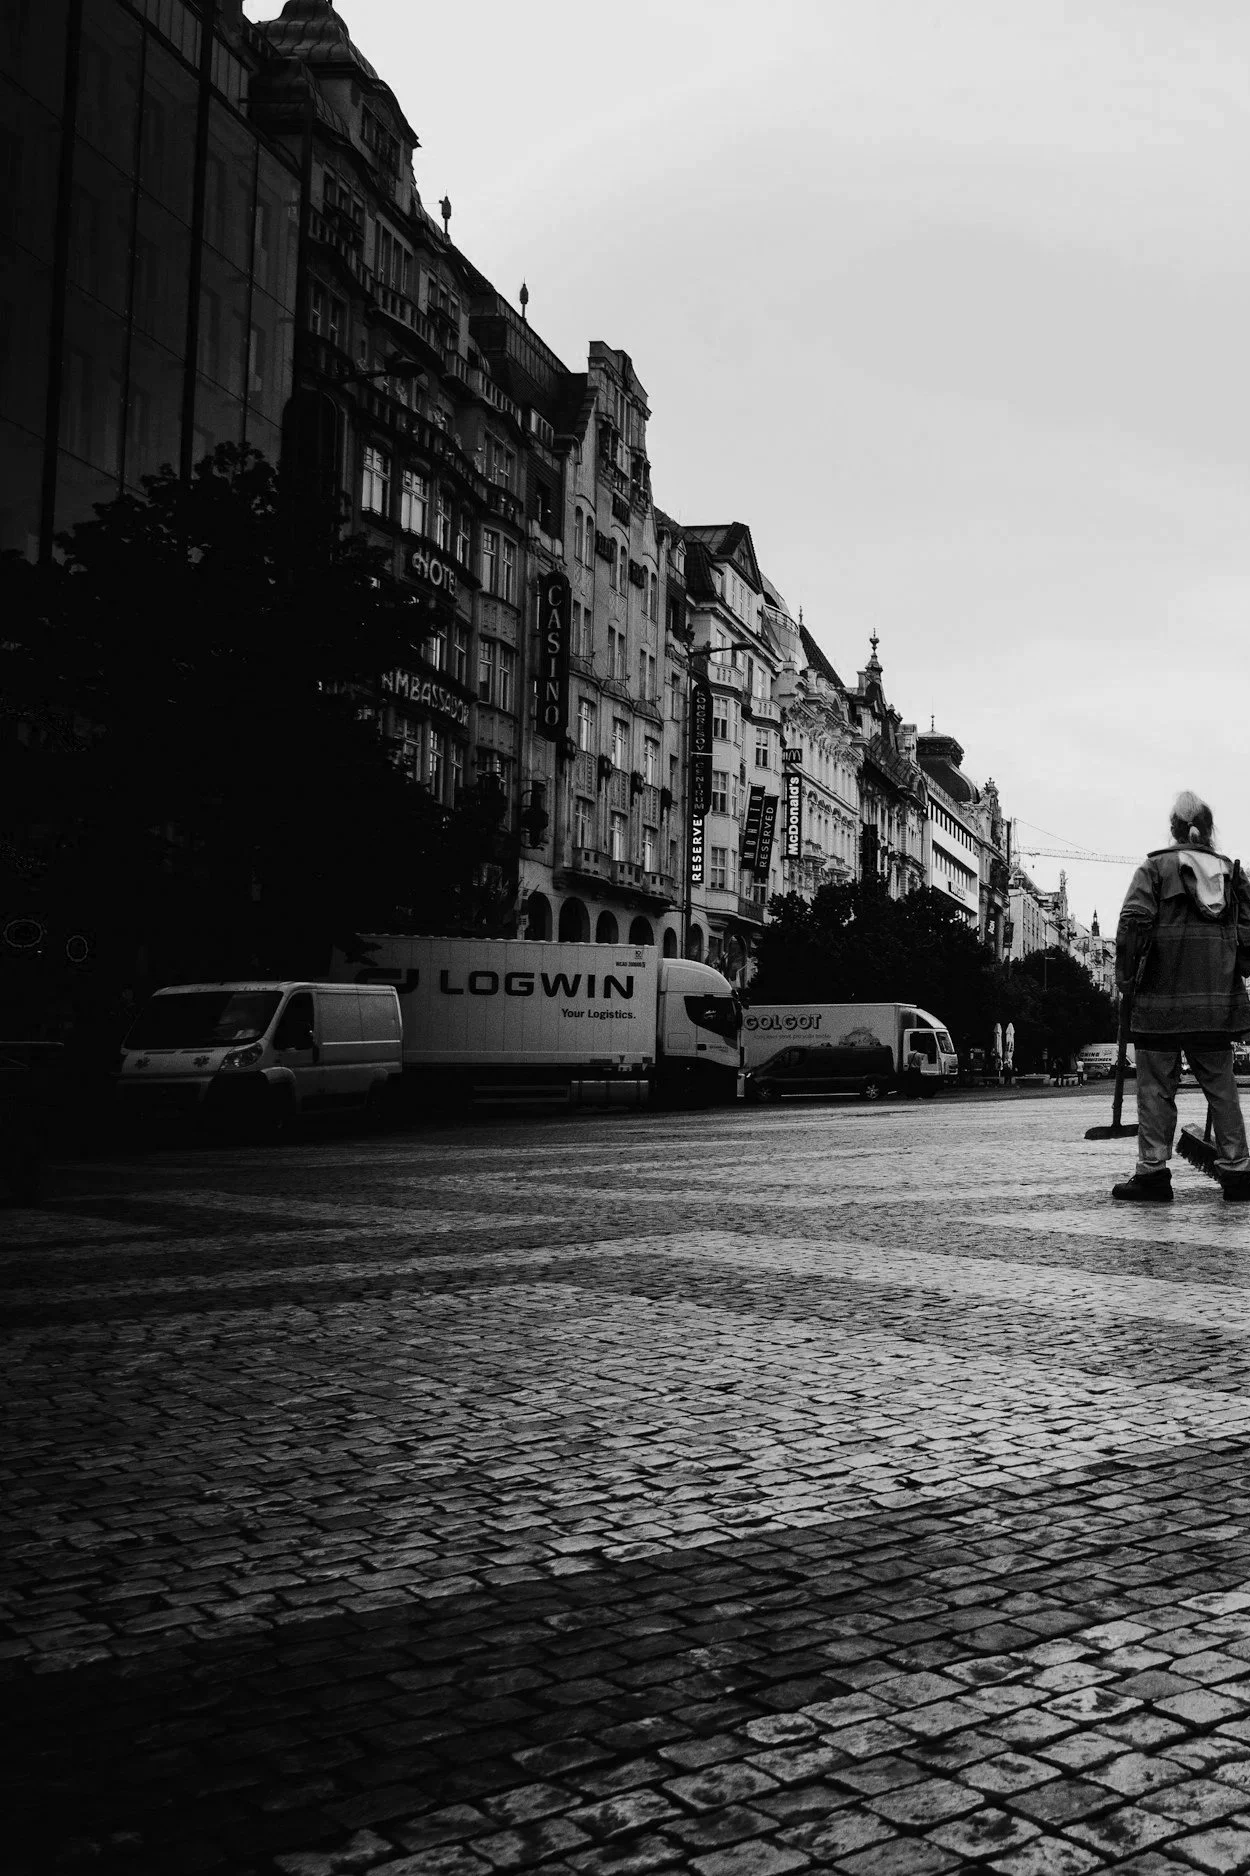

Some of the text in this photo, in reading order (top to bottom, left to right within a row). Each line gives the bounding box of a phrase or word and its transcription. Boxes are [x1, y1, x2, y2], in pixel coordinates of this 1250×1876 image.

[545, 584, 563, 727] CASINO
[743, 795, 763, 860] MOHITO
[758, 806, 774, 868] RESERVED
[788, 776, 800, 856] McDonald's
[691, 814, 703, 882] RESERVE
[440, 969, 634, 999] LOGWIN
[561, 1008, 636, 1020] Your Logistics.
[744, 1014, 821, 1030] GOLGOT
